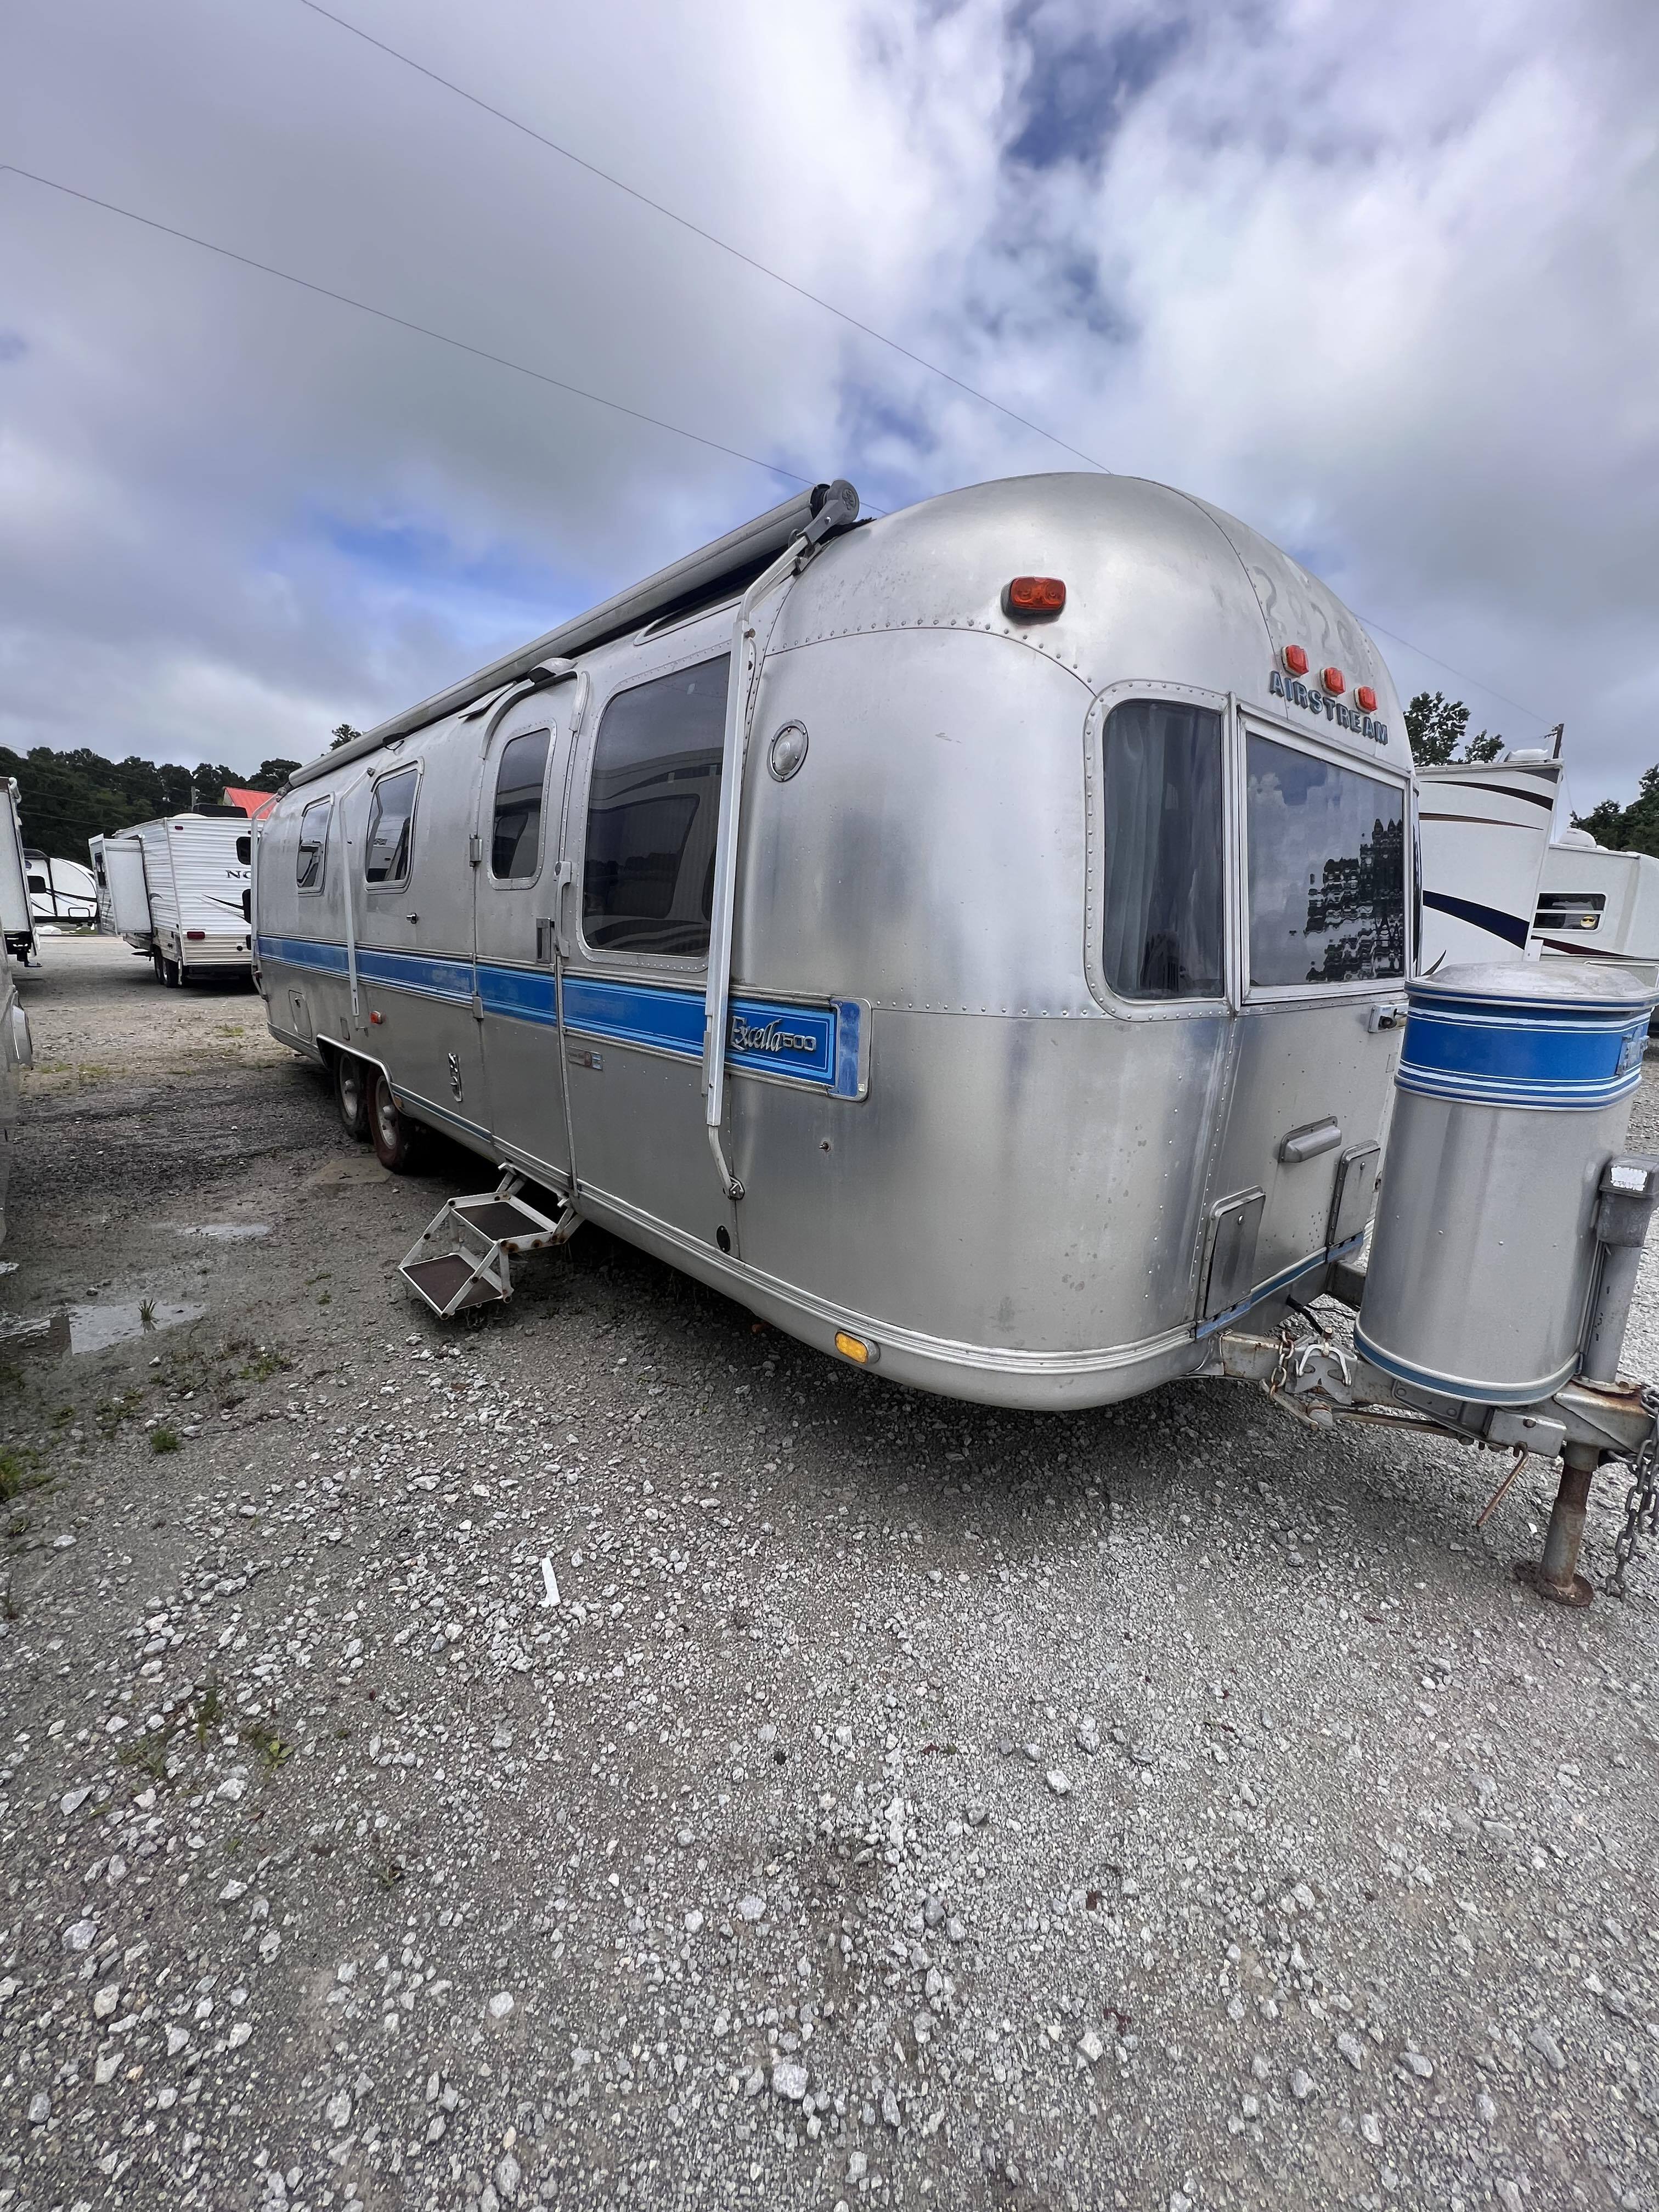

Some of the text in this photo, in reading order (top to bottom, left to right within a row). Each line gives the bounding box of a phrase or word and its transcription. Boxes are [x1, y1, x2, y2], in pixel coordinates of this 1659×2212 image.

[1269, 670, 1388, 745] AIRSTREAM
[730, 1015, 816, 1052] Excella 500
